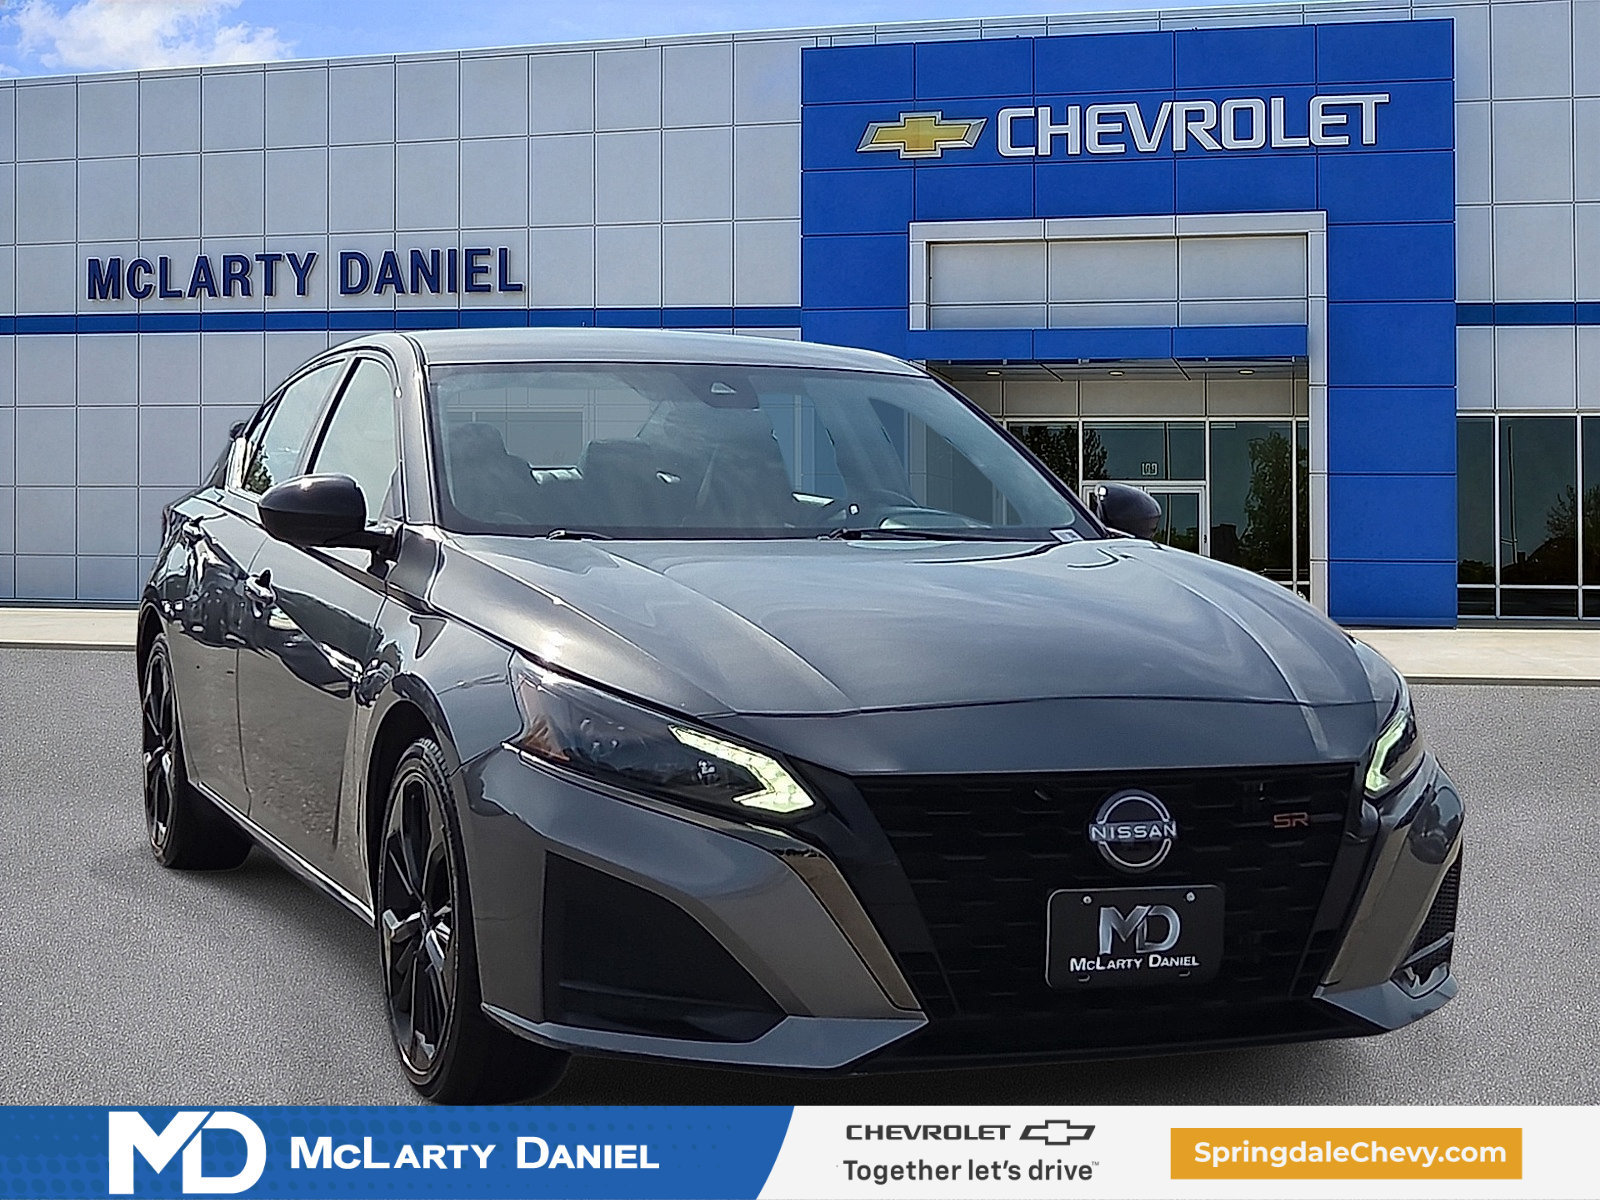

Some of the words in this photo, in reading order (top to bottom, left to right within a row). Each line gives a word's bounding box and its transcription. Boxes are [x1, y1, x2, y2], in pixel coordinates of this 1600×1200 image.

[996, 93, 1390, 158] CHEVROLET
[338, 246, 525, 297] DANIEL
[1089, 822, 1178, 841] NISSAN
[1273, 812, 1309, 829] SR
[1098, 904, 1181, 955] MD
